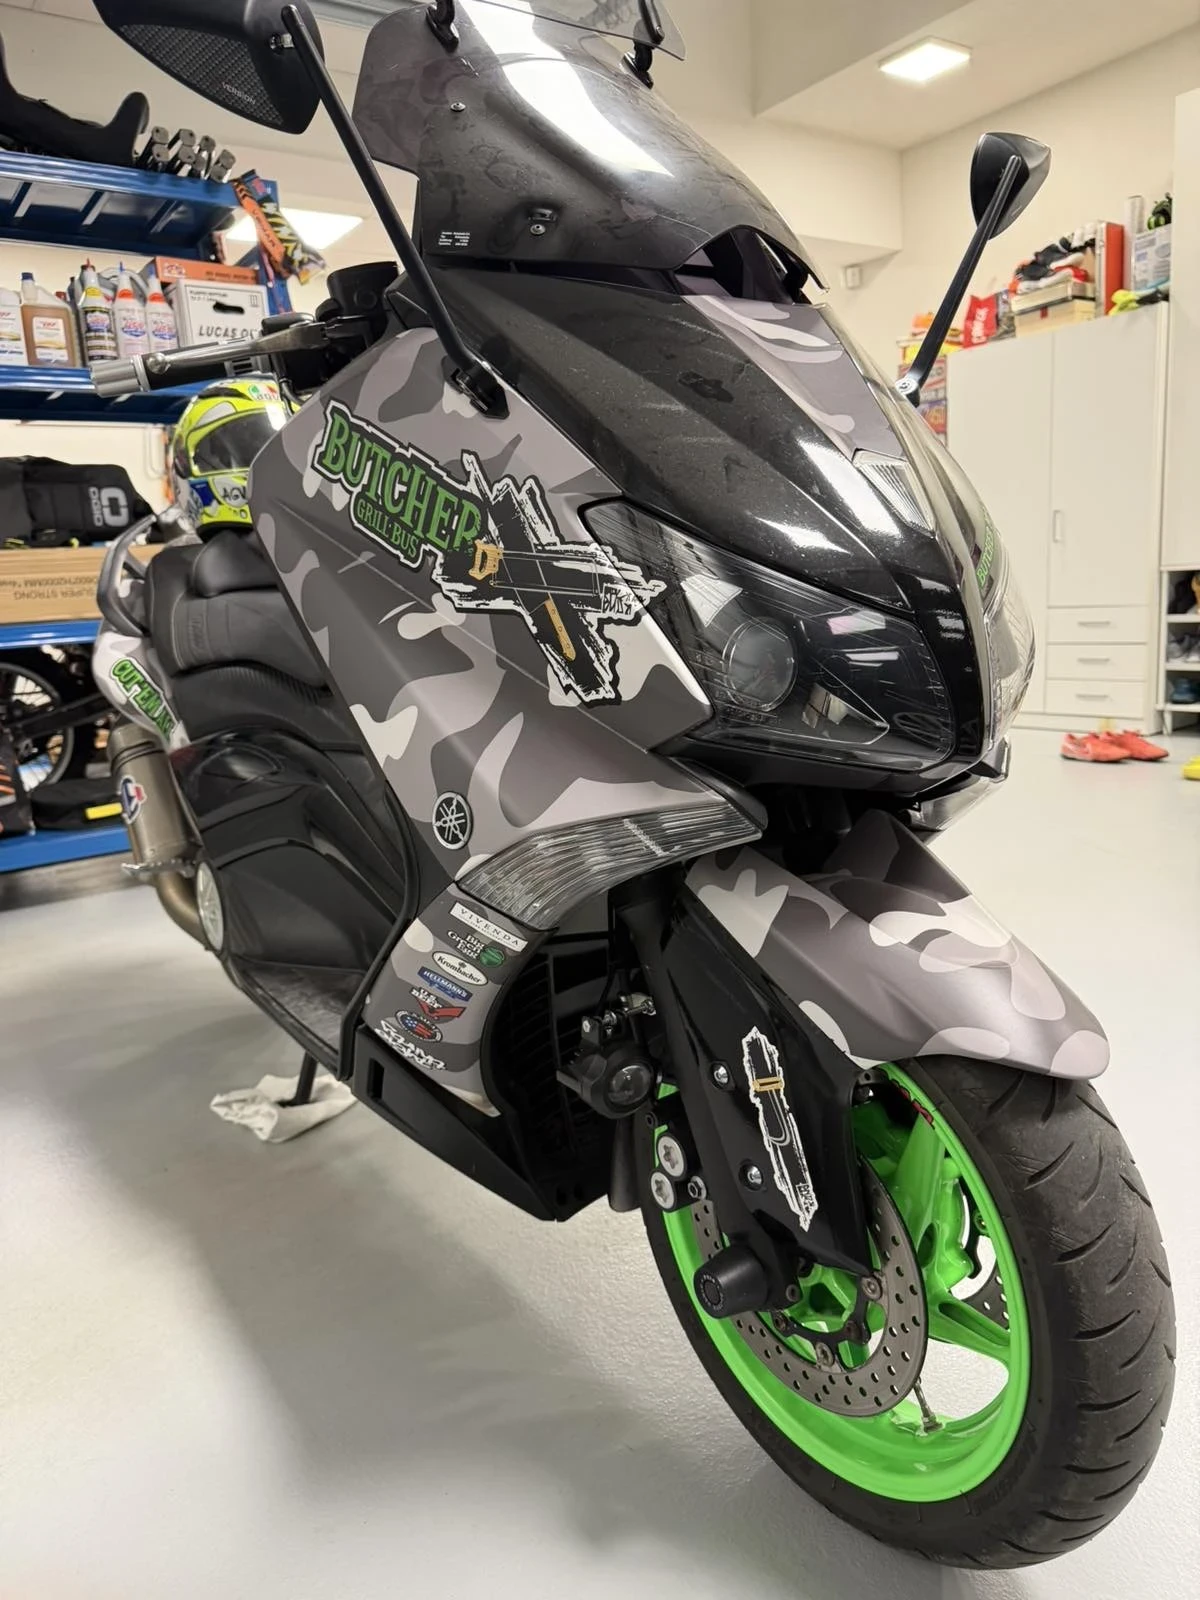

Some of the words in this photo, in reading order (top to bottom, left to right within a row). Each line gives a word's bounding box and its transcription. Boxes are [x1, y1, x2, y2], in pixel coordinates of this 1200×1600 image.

[198, 324, 237, 338] LUCAS
[322, 412, 482, 551] BUTCHER
[88, 486, 103, 527] OGIO
[461, 908, 519, 946] VIVENDA
[466, 934, 485, 948] Big
[447, 931, 483, 954] Green
[456, 942, 479, 959] Egg
[423, 970, 468, 998] HELLMANN'S
[437, 956, 482, 984] Krombacher
